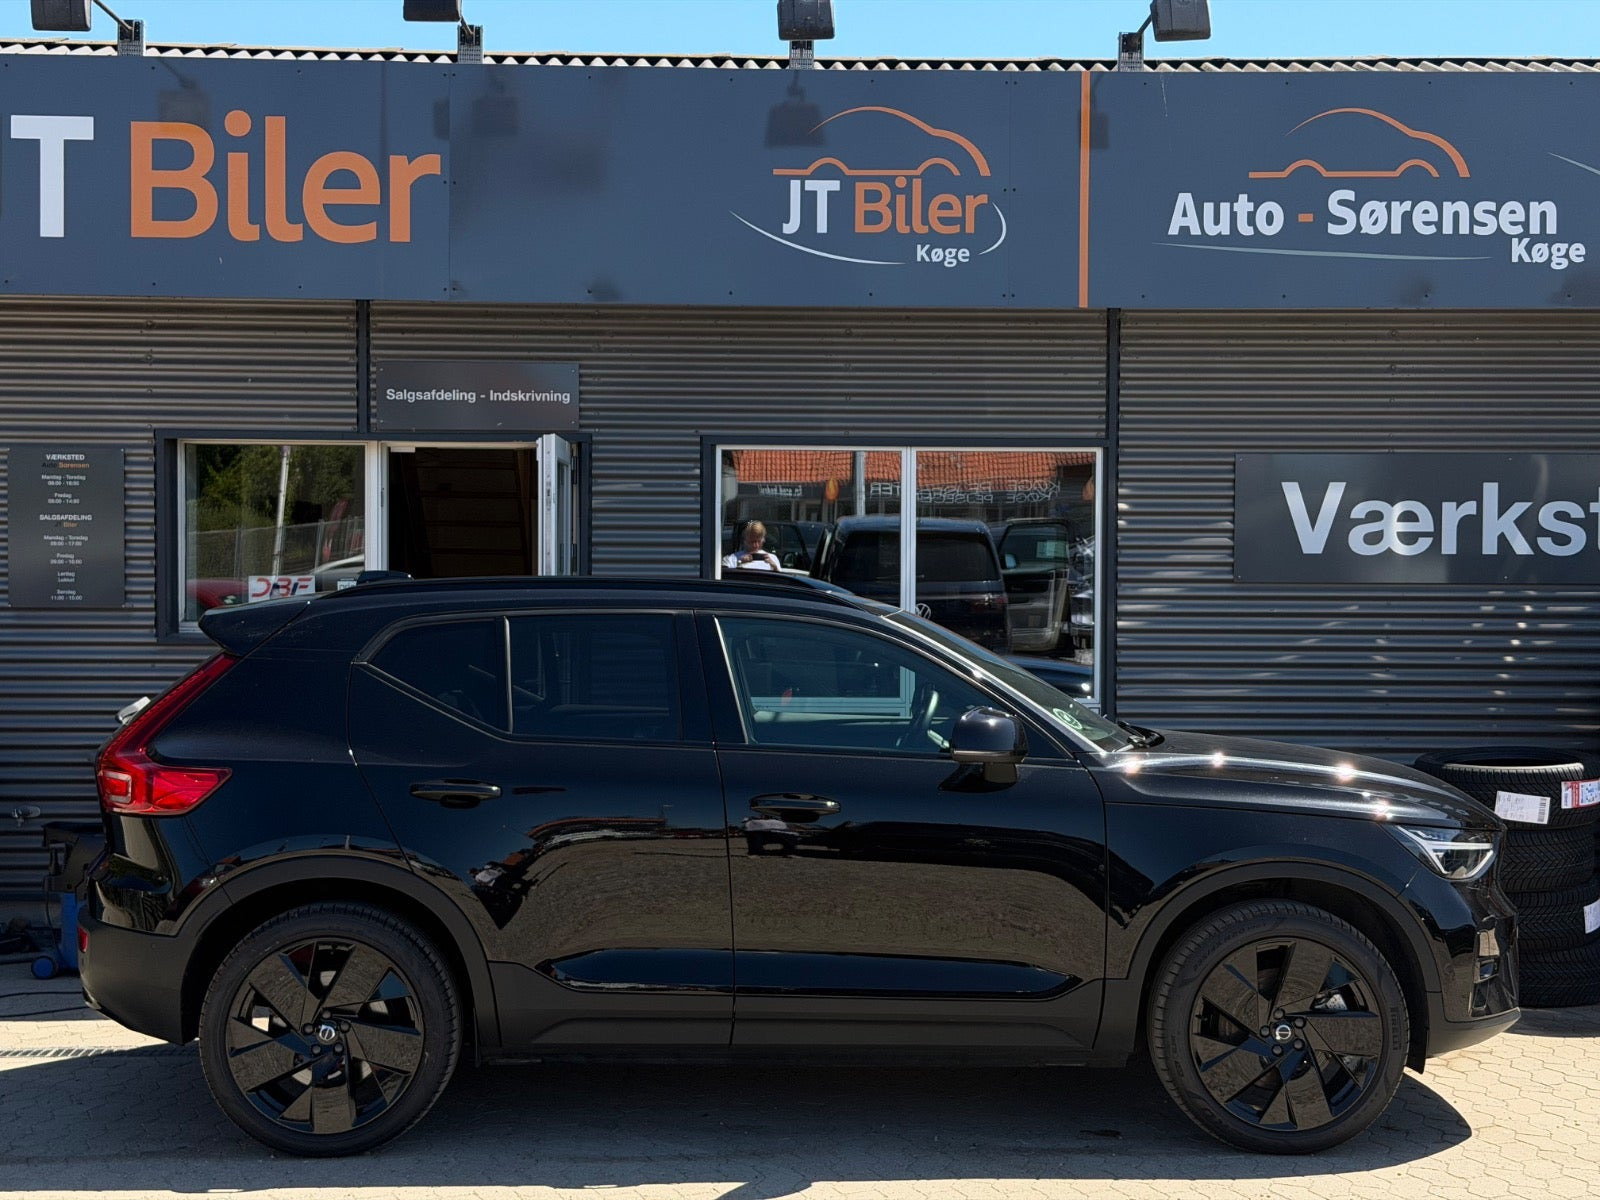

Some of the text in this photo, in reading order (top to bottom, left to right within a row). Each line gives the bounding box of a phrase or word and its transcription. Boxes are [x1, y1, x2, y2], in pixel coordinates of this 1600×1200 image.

[130, 109, 441, 243] Biler
[782, 175, 988, 235] JT Biler
[1167, 192, 1285, 236] Auto
[1327, 189, 1558, 236] Sørensen
[916, 244, 970, 268] Køge
[1511, 237, 1586, 270] Køge
[386, 388, 477, 404] Salgsafdeling
[489, 388, 571, 405] Indskrivning
